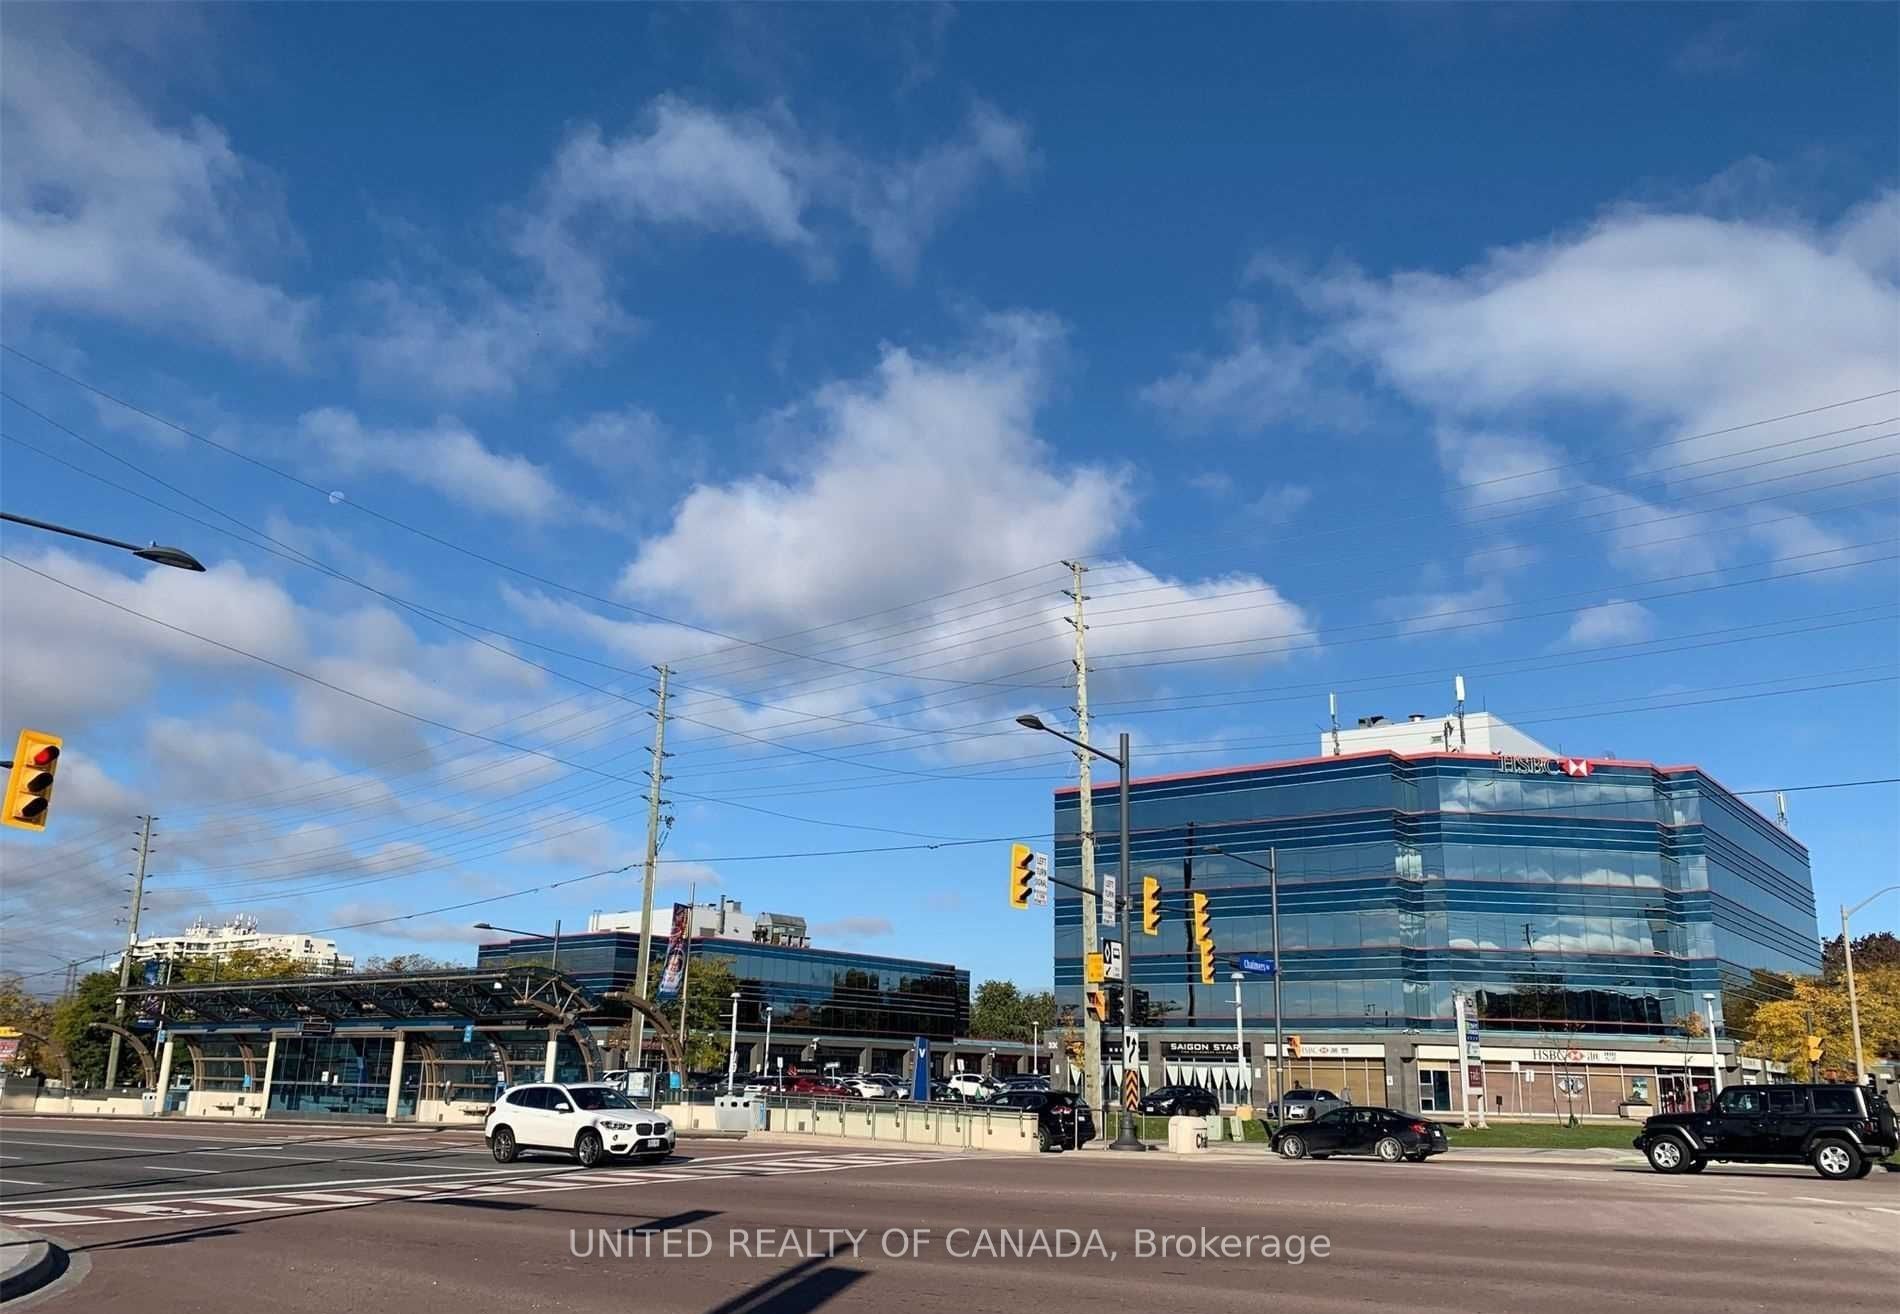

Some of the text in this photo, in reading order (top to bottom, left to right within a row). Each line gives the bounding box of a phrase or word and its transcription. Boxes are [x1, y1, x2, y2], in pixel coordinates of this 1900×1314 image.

[1499, 755, 1561, 775] HSBC
[1170, 1043, 1240, 1051] SAIGON STAR
[1533, 1049, 1566, 1061] HSBC
